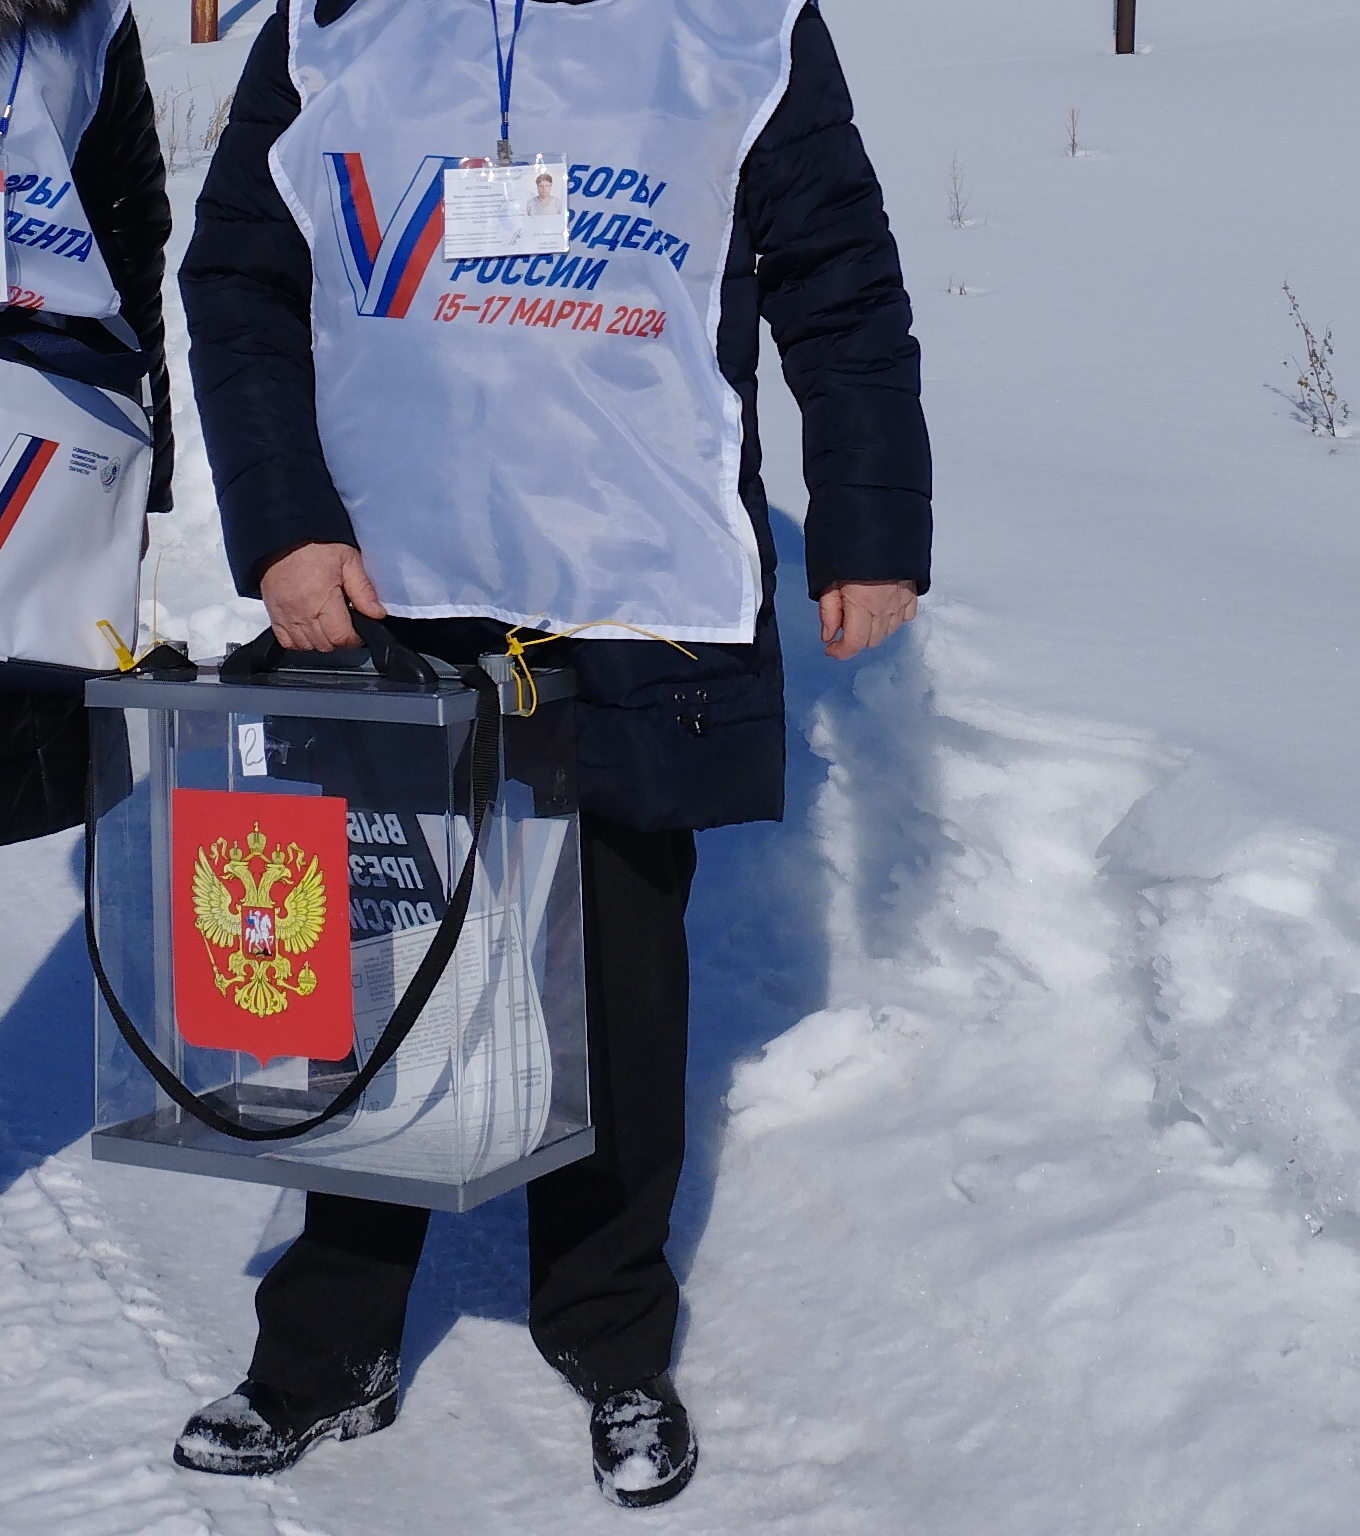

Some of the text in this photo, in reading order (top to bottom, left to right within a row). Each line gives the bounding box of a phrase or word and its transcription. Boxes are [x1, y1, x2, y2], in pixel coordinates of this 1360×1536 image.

[508, 297, 604, 333] МАРТА
[605, 305, 667, 340] 2024
[244, 727, 265, 767] 2
